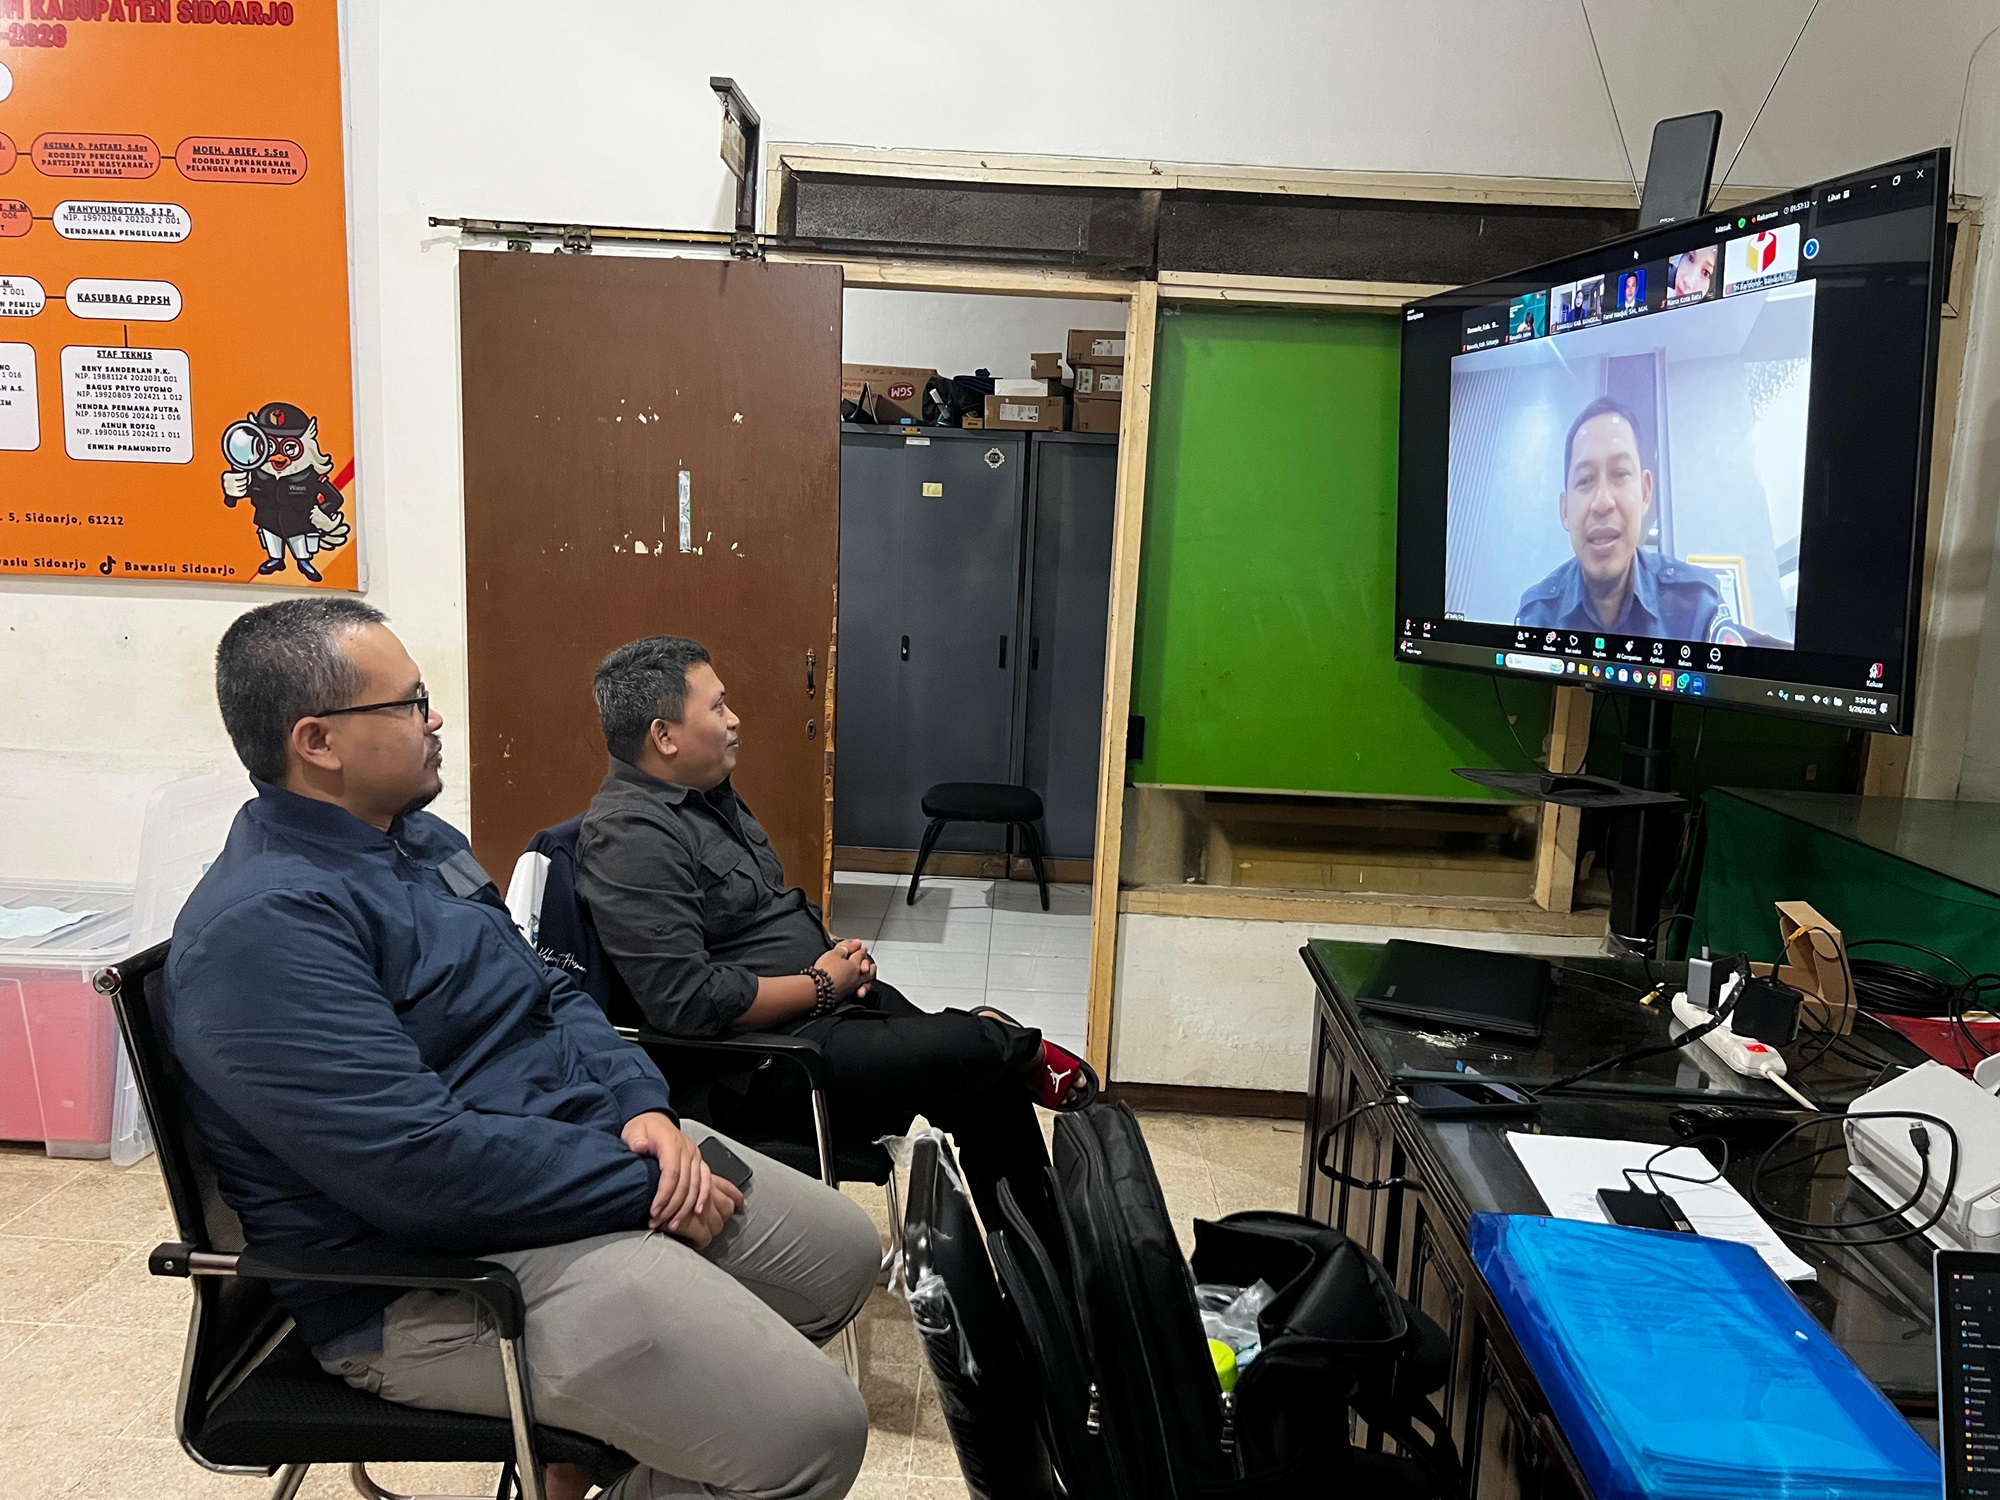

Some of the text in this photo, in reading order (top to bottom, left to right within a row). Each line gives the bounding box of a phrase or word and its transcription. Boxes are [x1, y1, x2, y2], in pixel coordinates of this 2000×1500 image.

[30, 0, 171, 23] KABUPATEN
[177, 0, 294, 26] SIDOARJO
[44, 142, 75, 151] AGISMA
[264, 148, 289, 157] S.Sos
[42, 159, 154, 169] PARTISIPASI MASYARAKAT
[234, 159, 291, 167] PENANGANAN
[186, 165, 247, 173] PELANGGARAN
[63, 214, 80, 222] NIP.
[83, 214, 121, 222] 19970204
[125, 216, 154, 224] 202203
[166, 217, 181, 225] 001
[65, 228, 181, 238] BENDAHARA PENGELUARAN
[77, 293, 171, 306] KASUBBAG PPPSH
[97, 350, 153, 360] STAF TEKNIS
[105, 366, 152, 374] SANDERLAN
[95, 391, 131, 399] 19920809
[891, 386, 913, 398] SGM
[112, 404, 150, 412] PERMANA
[93, 411, 130, 419] 19870506
[132, 412, 158, 420] 202421
[95, 429, 130, 437] 19900115
[132, 430, 158, 438] 202421
[117, 444, 172, 453] PRAMUNDITO
[8, 513, 124, 526] 5, Sidoarjo, 61212
[34, 558, 87, 569] Sidoarjo
[124, 562, 236, 576] Bawaslu Sidoarjo
